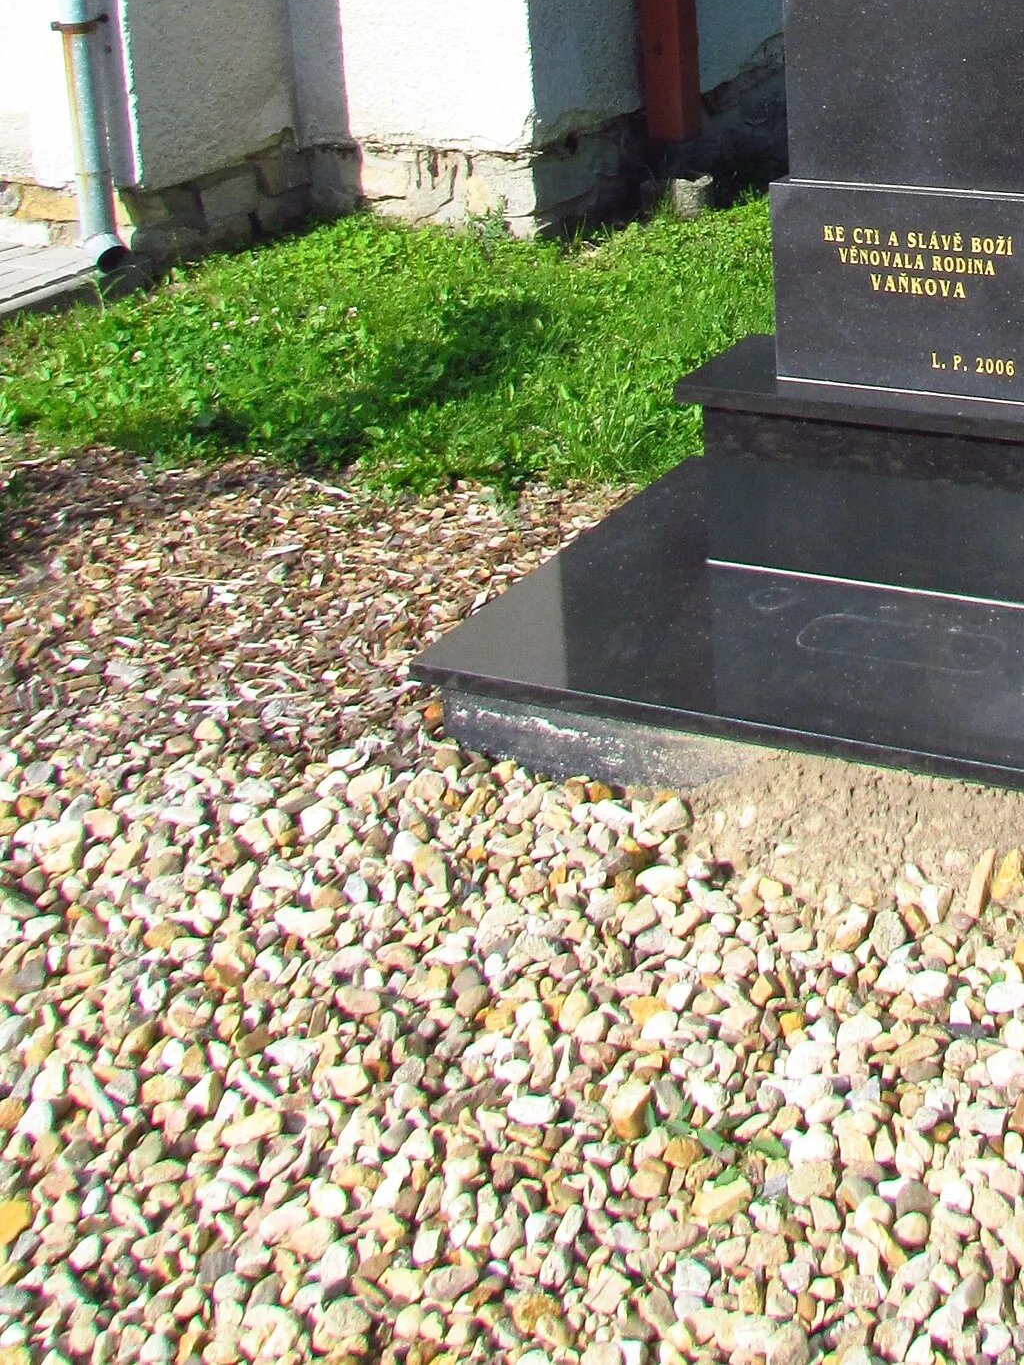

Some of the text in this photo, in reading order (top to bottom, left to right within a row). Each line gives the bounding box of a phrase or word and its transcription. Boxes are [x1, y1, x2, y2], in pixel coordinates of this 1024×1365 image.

[823, 225, 1013, 256] KE CTI A SLÁVĚ BOŽÍ
[838, 245, 996, 276] VĚNOVALA RODINA
[870, 272, 966, 299] VAŇKOVA
[932, 353, 1015, 377] L. P. 2006
